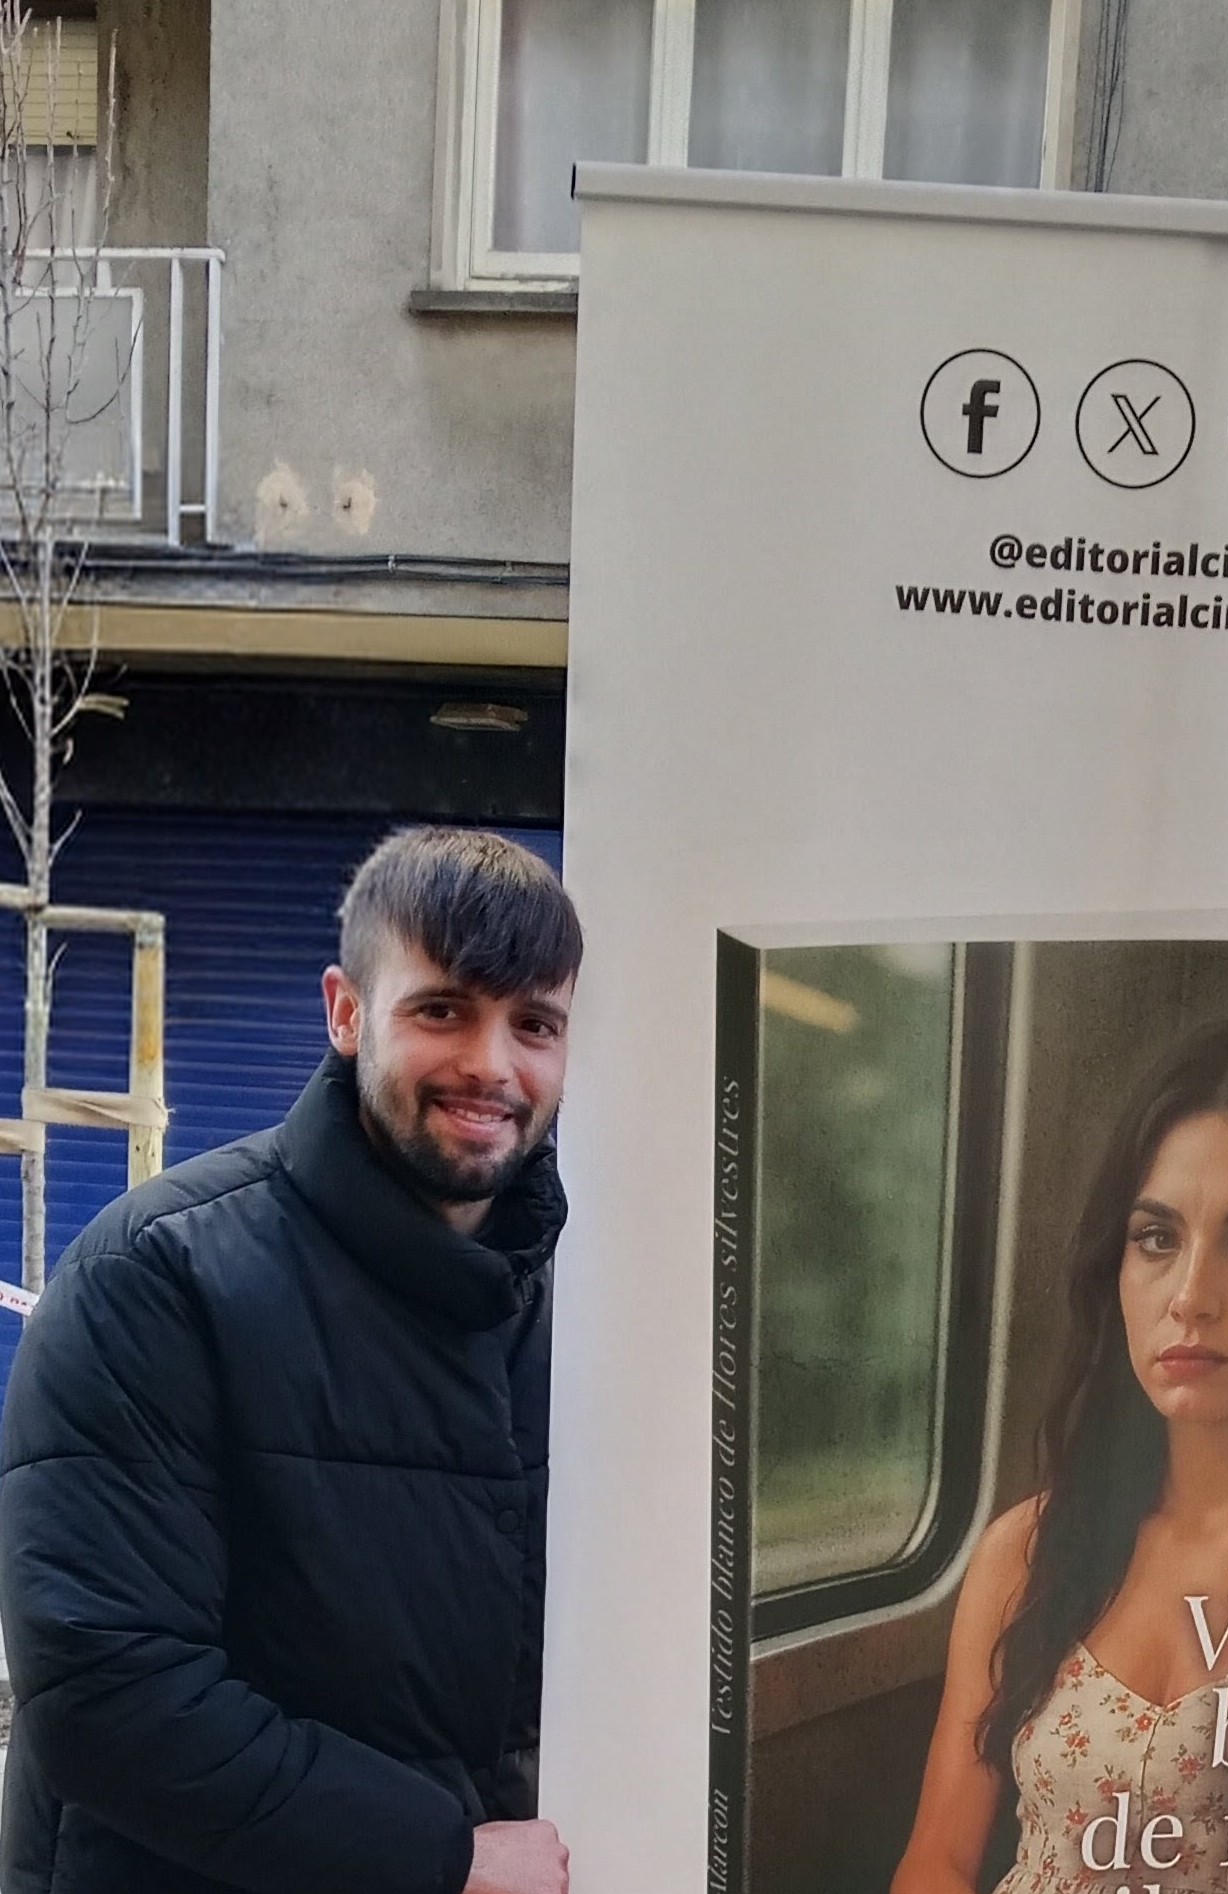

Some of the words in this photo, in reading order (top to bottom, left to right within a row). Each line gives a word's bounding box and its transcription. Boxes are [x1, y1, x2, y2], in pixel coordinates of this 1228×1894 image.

[712, 1075, 740, 1273] silvestres
[711, 1419, 736, 1468] de
[710, 1477, 736, 1601] blanco
[1080, 1791, 1184, 1871] de
